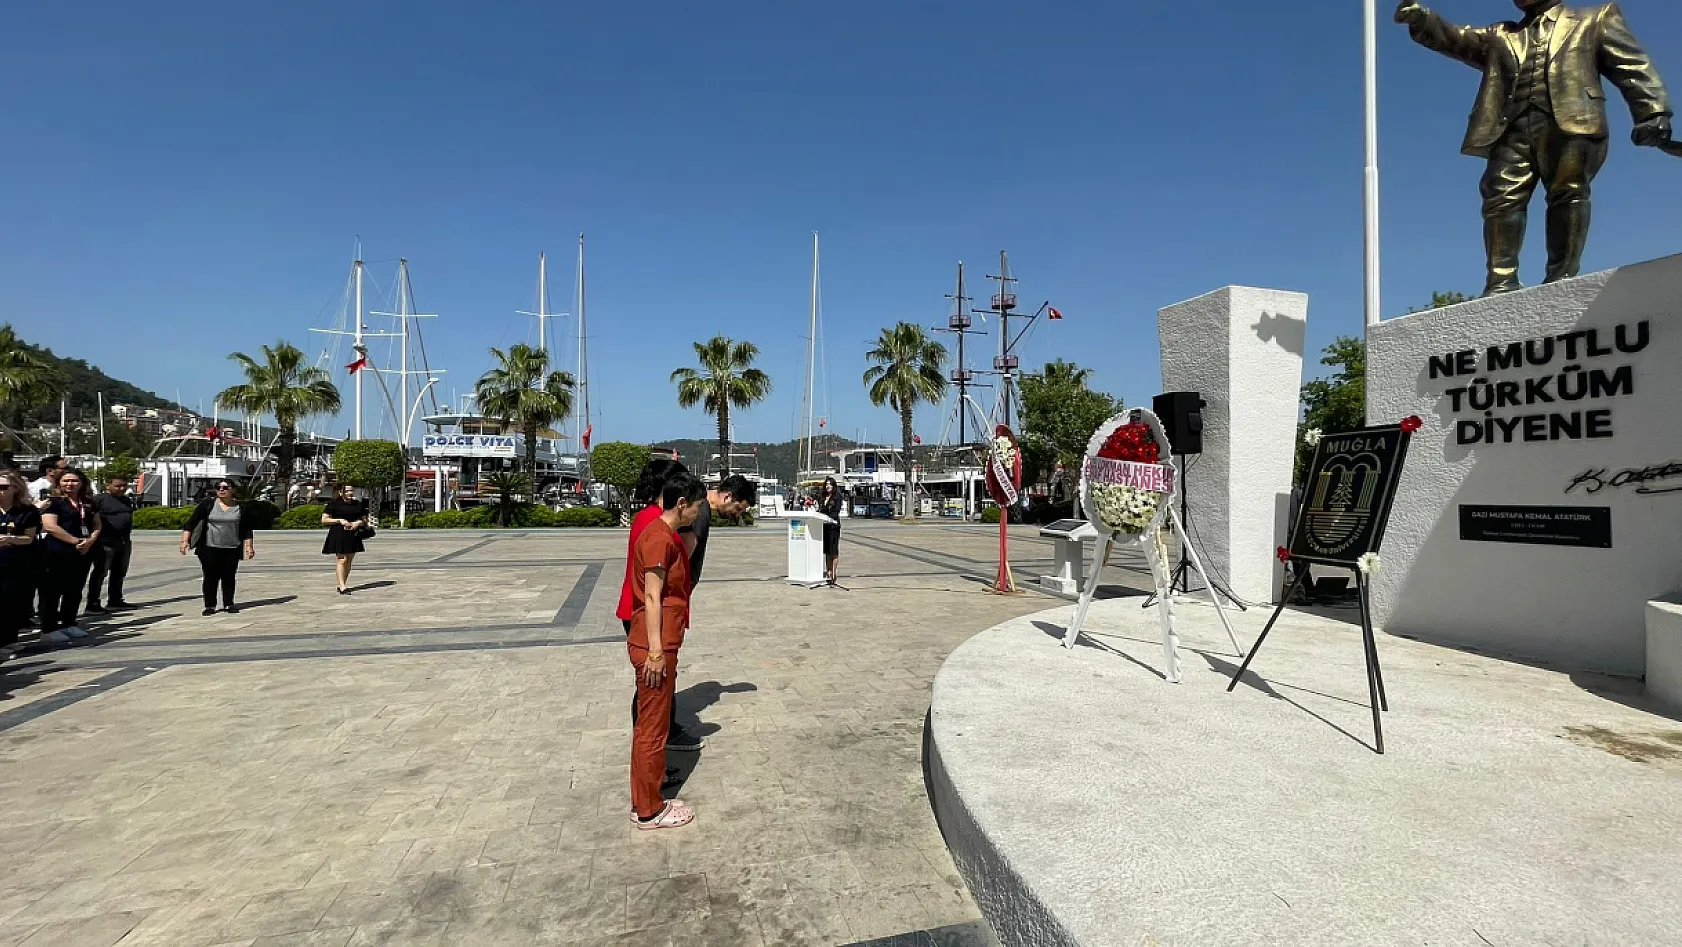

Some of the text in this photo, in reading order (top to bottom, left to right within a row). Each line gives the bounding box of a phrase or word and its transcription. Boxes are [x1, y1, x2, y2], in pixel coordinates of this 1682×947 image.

[1428, 320, 1650, 379] NE MUTLU
[1445, 364, 1633, 412] TÜRKÜM
[1456, 410, 1614, 445] DİYENE
[424, 436, 515, 447] DOLCE VITA
[1326, 436, 1386, 454] MUĞLA
[1525, 512, 1553, 521] KEMAL
